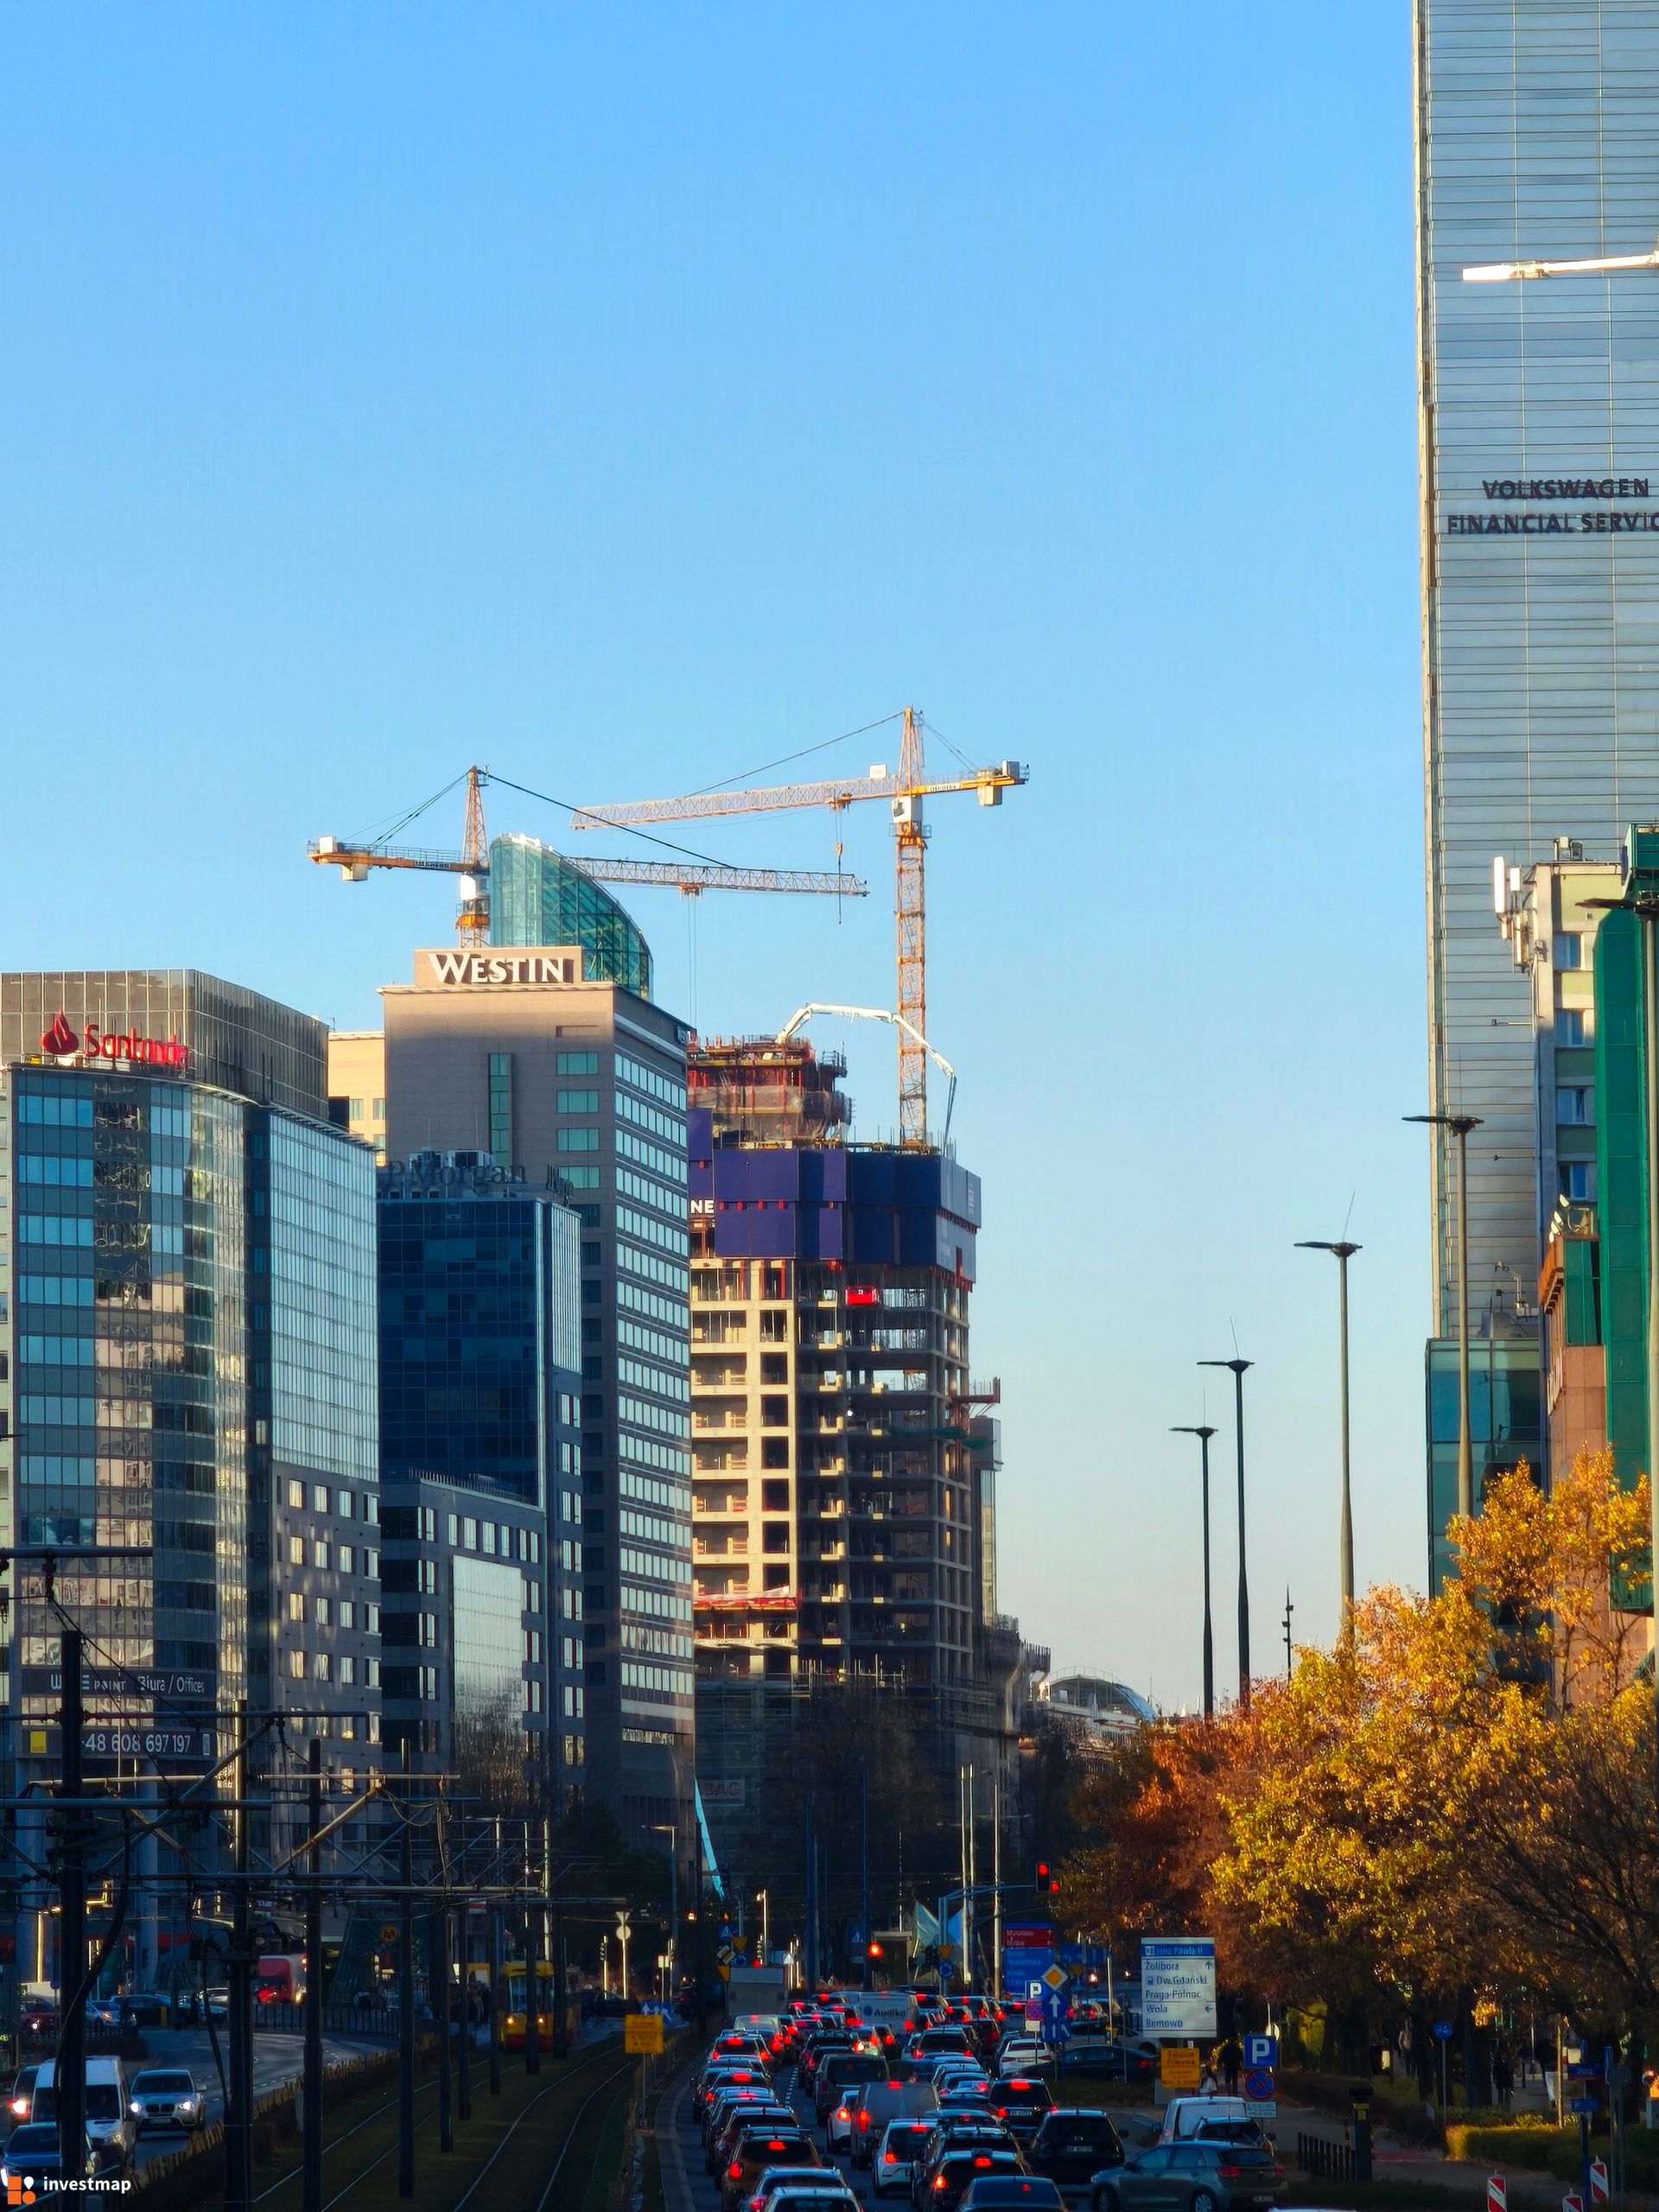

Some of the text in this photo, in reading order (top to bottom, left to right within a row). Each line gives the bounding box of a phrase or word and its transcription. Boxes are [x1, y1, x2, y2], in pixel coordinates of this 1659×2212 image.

[1482, 478, 1649, 499] VOLKSWAGEN
[1447, 512, 1574, 534] FINANCIAL
[94, 1680, 126, 1691] POINT
[137, 1675, 166, 1692] Biura
[176, 1675, 205, 1694] Offices
[111, 1733, 141, 1753] 608
[145, 1733, 169, 1753] 697
[171, 1733, 191, 1753] 197
[1029, 1982, 1042, 1999] P
[1146, 2004, 1168, 2013] Wola
[1251, 2040, 1270, 2063] P
